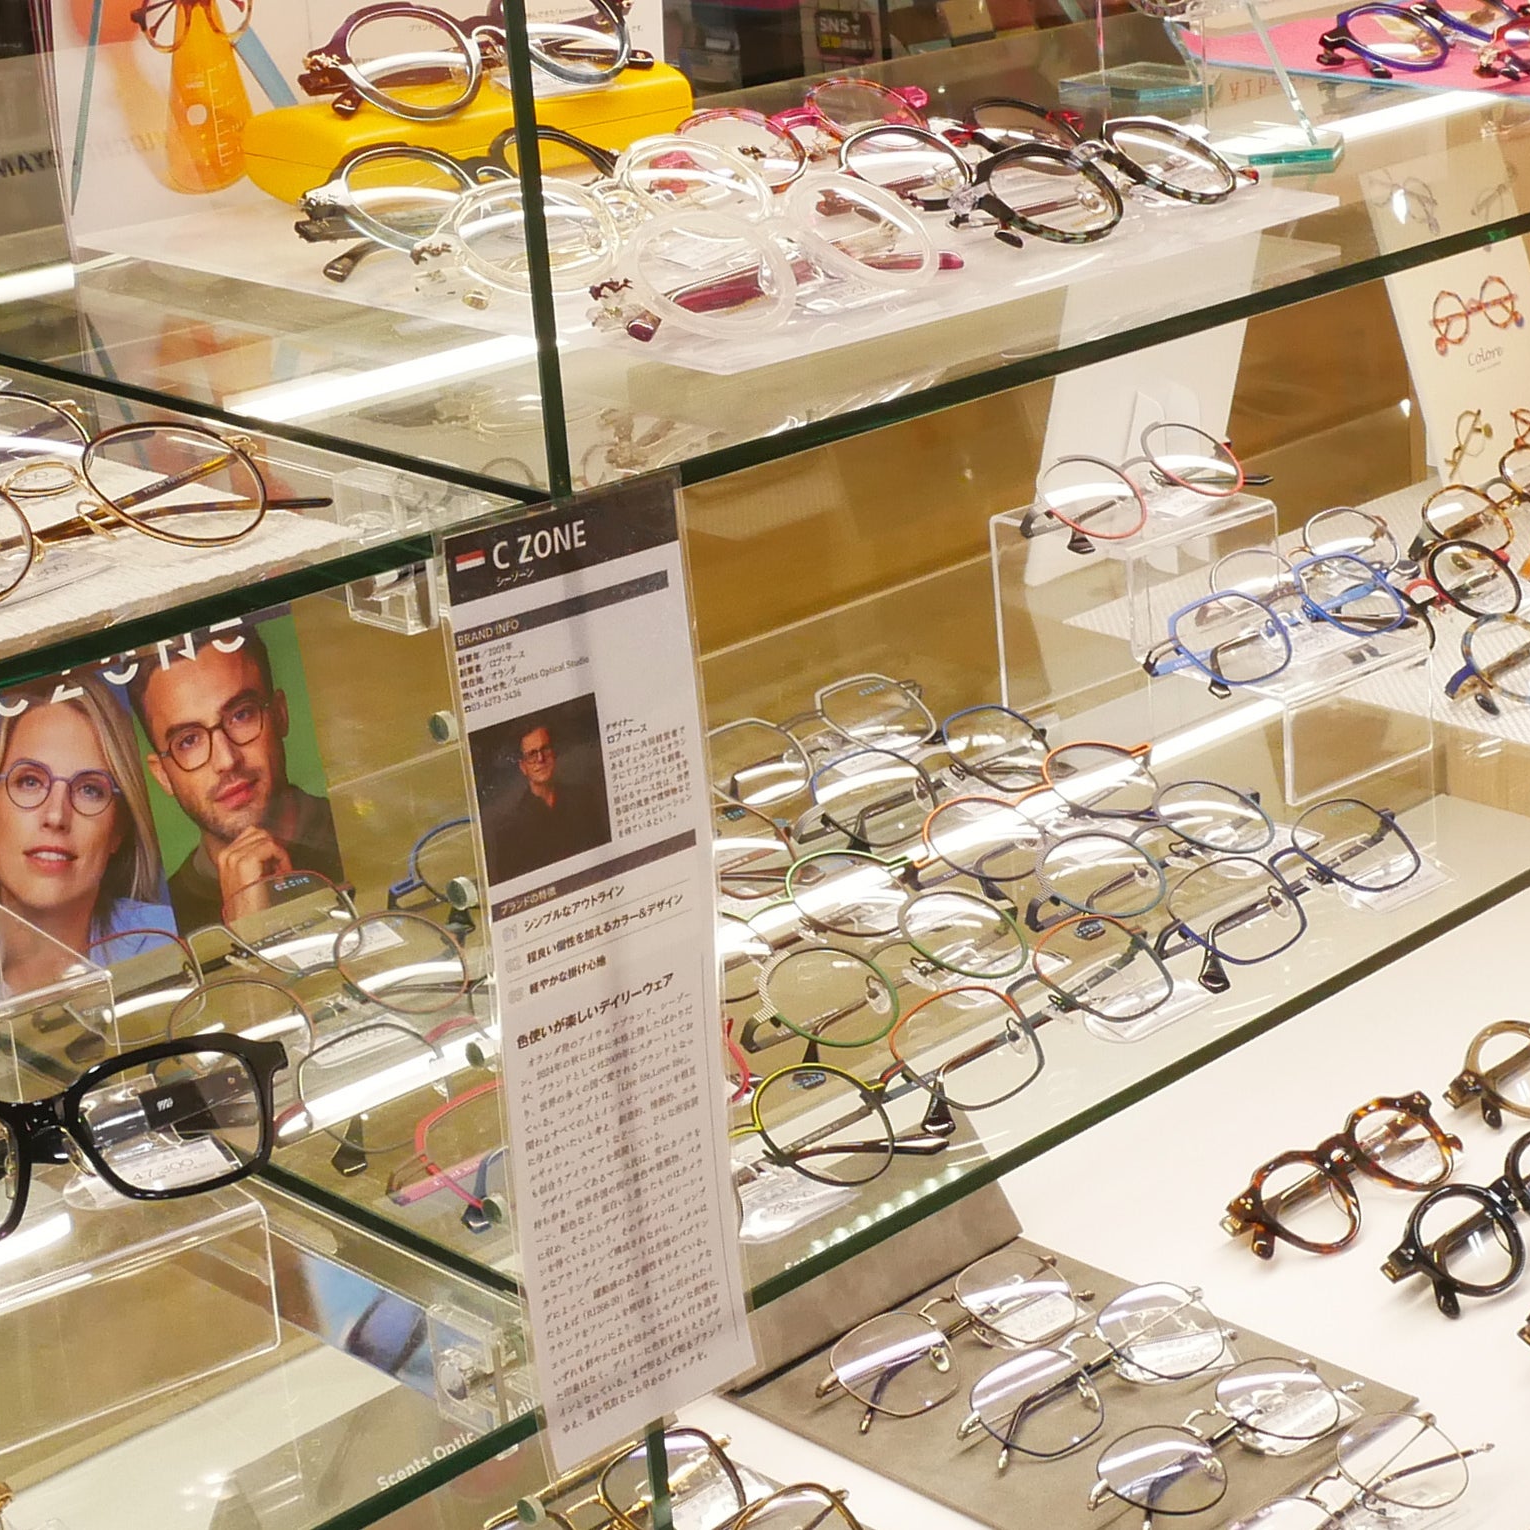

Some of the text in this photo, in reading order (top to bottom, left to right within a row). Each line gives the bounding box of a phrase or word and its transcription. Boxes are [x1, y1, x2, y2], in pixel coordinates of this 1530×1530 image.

[491, 519, 586, 571] C ZONE
[457, 619, 519, 646] BRAND INFO
[523, 883, 625, 932] シンプルなアウトライン
